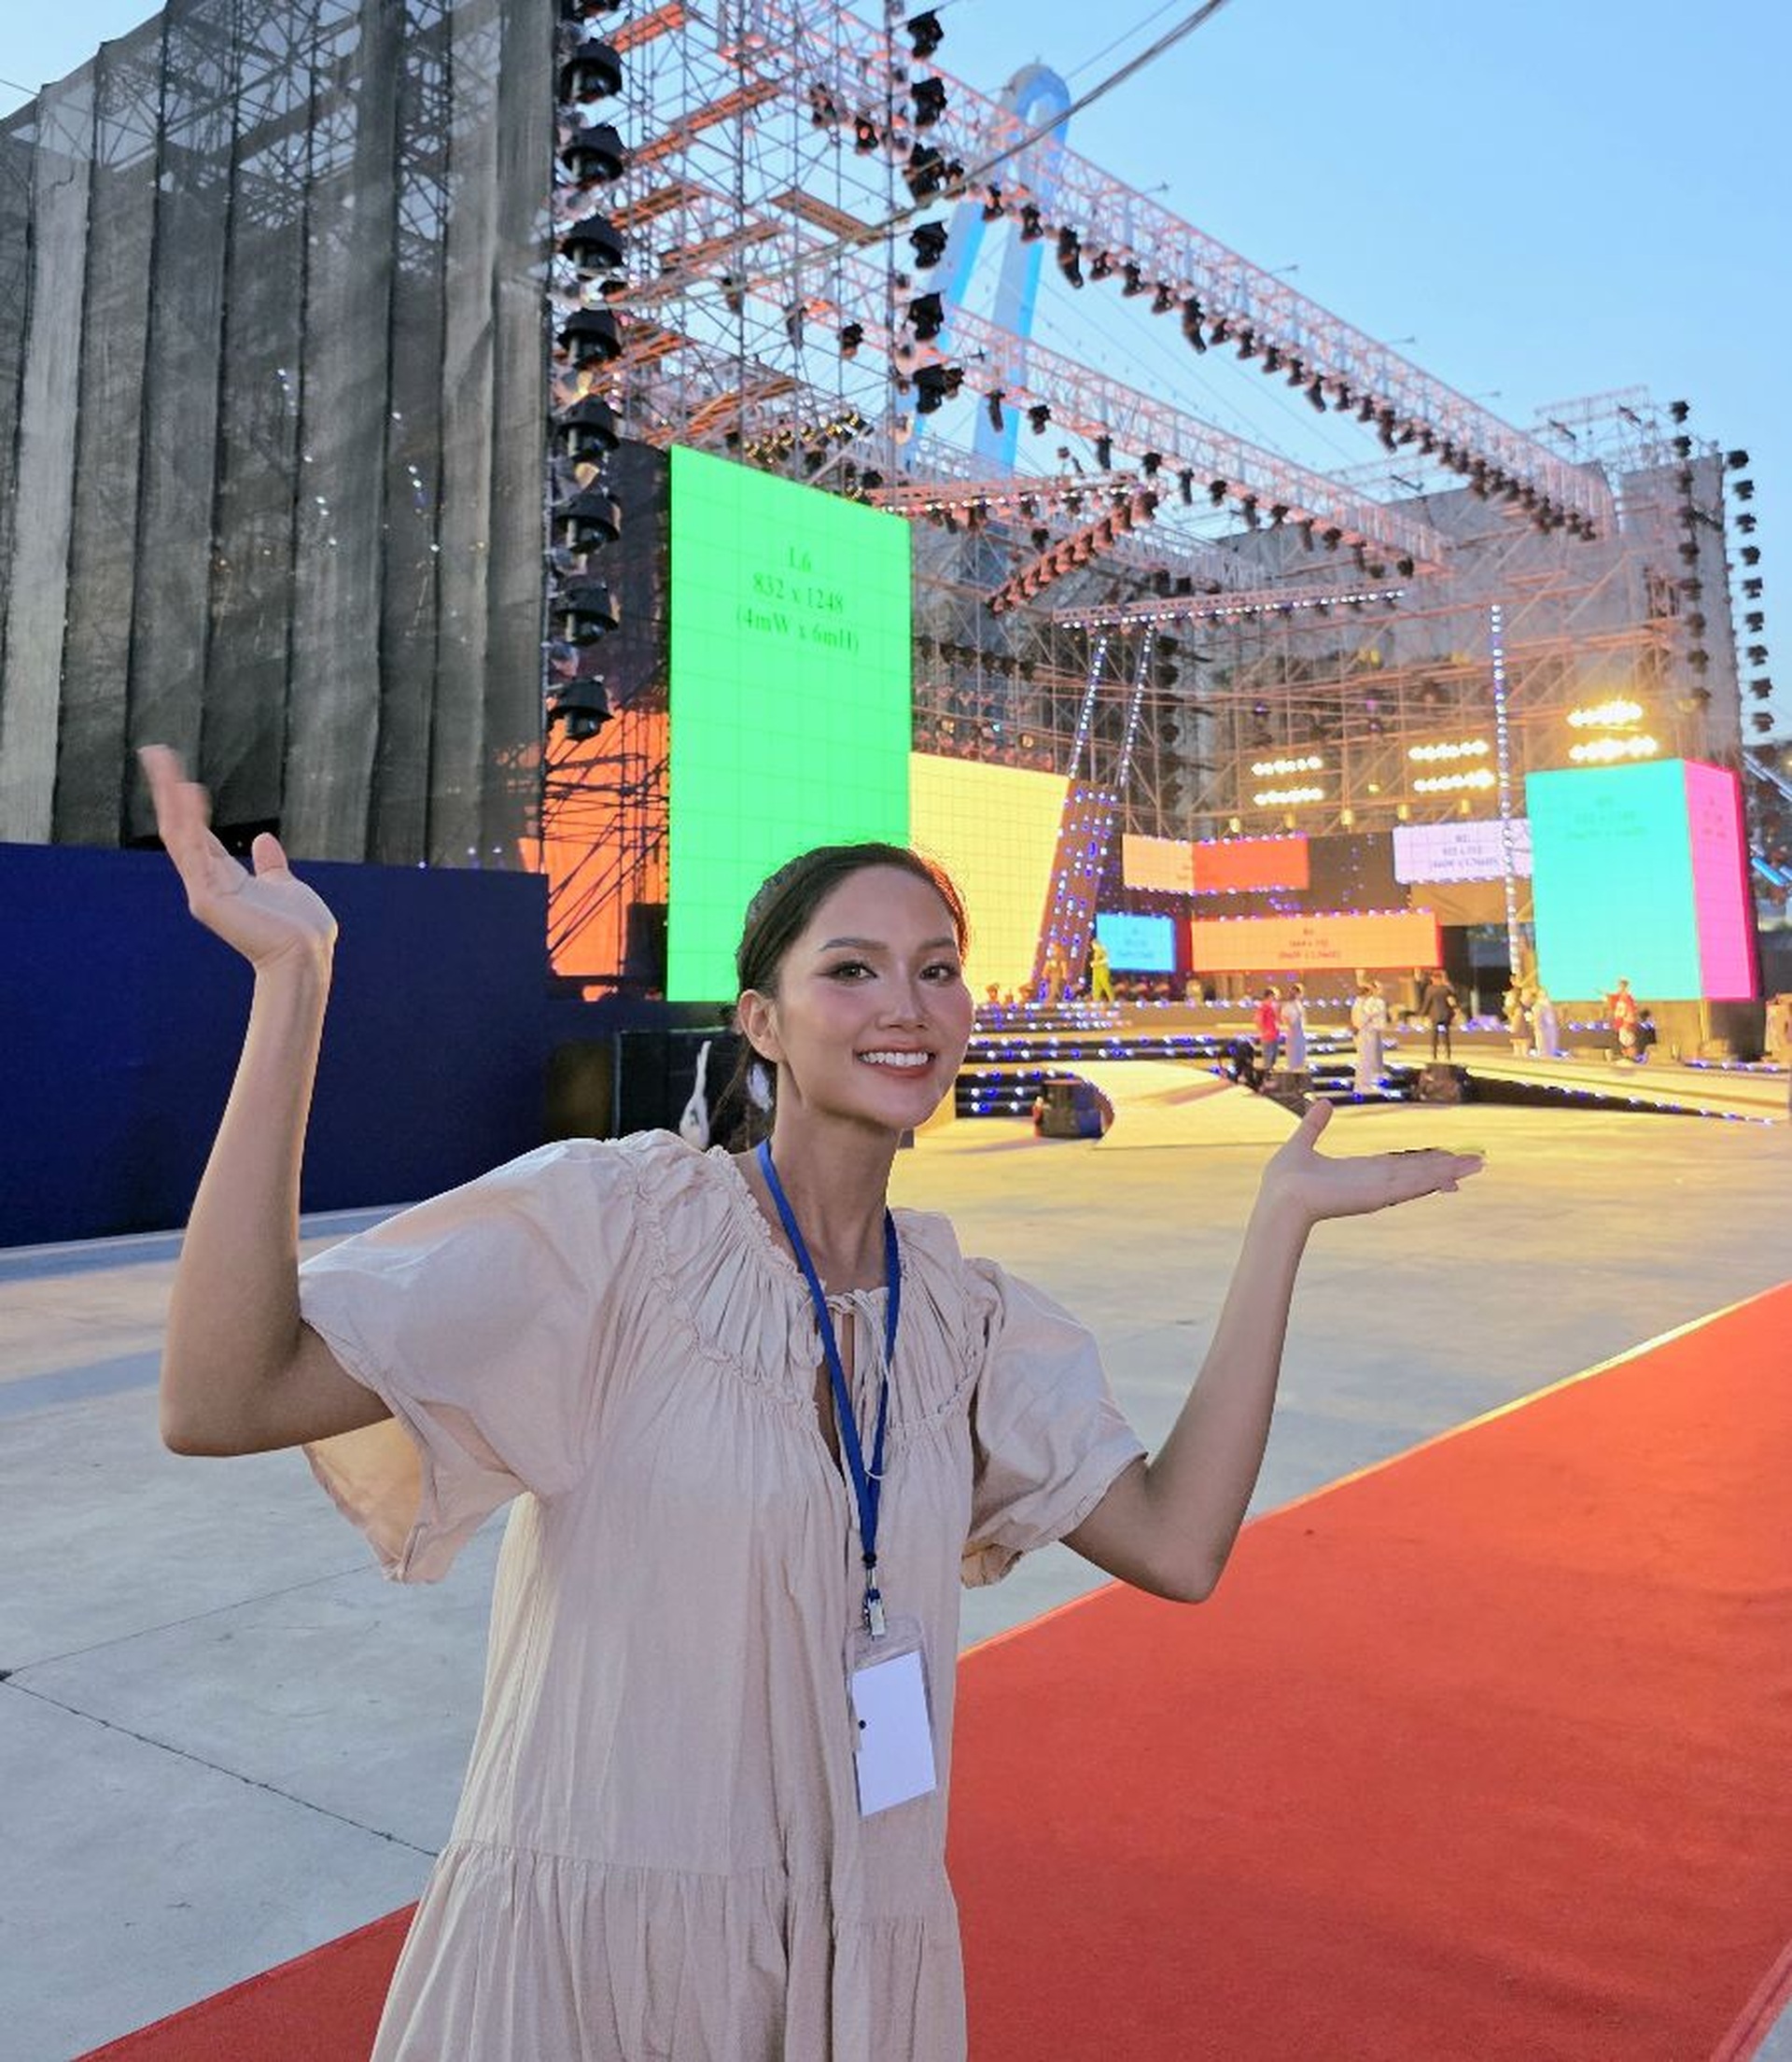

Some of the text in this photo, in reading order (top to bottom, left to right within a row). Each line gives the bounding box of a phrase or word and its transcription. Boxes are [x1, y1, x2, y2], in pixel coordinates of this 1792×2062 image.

[789, 546, 812, 573] L6
[752, 572, 844, 614] 832 x 1248
[736, 603, 860, 656] (4mW x 6mH)
